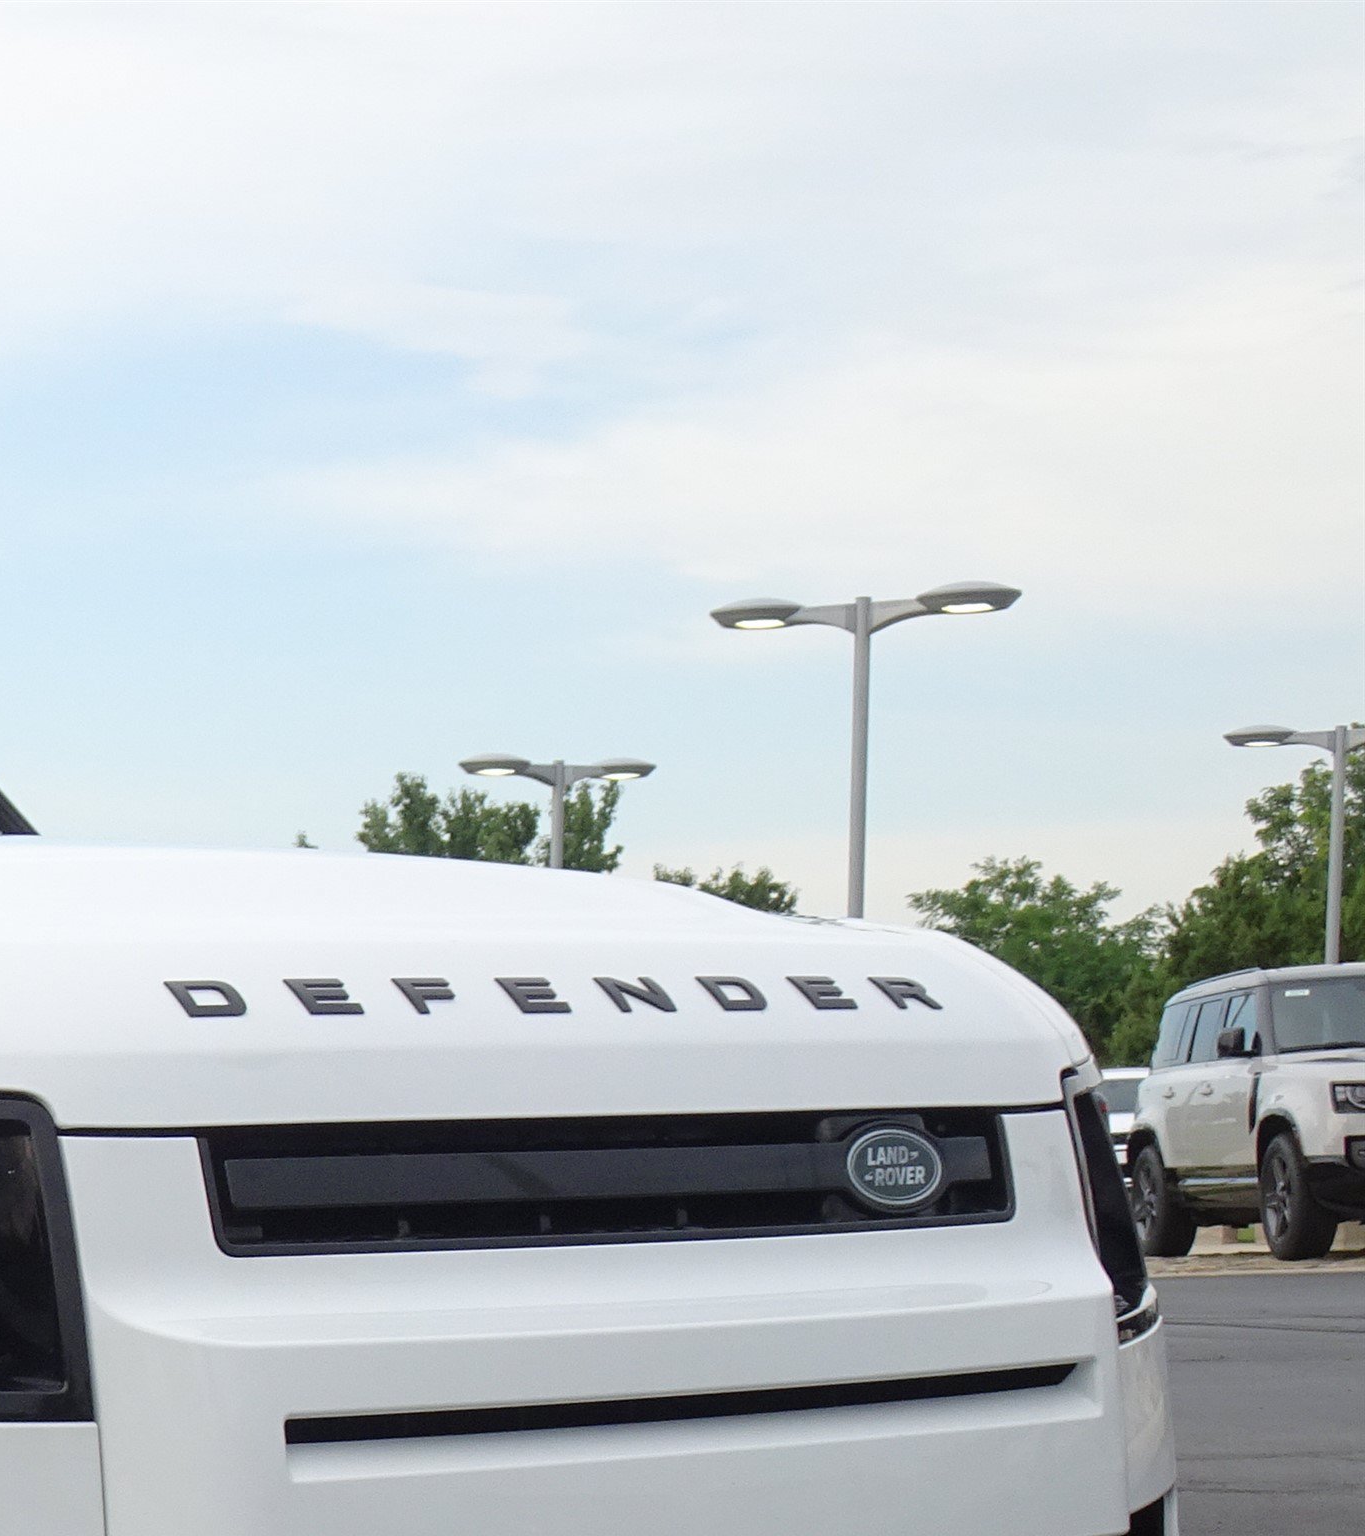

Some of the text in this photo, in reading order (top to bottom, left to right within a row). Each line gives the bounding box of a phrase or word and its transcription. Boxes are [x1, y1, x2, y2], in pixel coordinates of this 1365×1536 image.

[164, 975, 944, 1017] DEFENDER
[866, 1145, 910, 1167] LAND
[874, 1166, 926, 1187] ROVER
